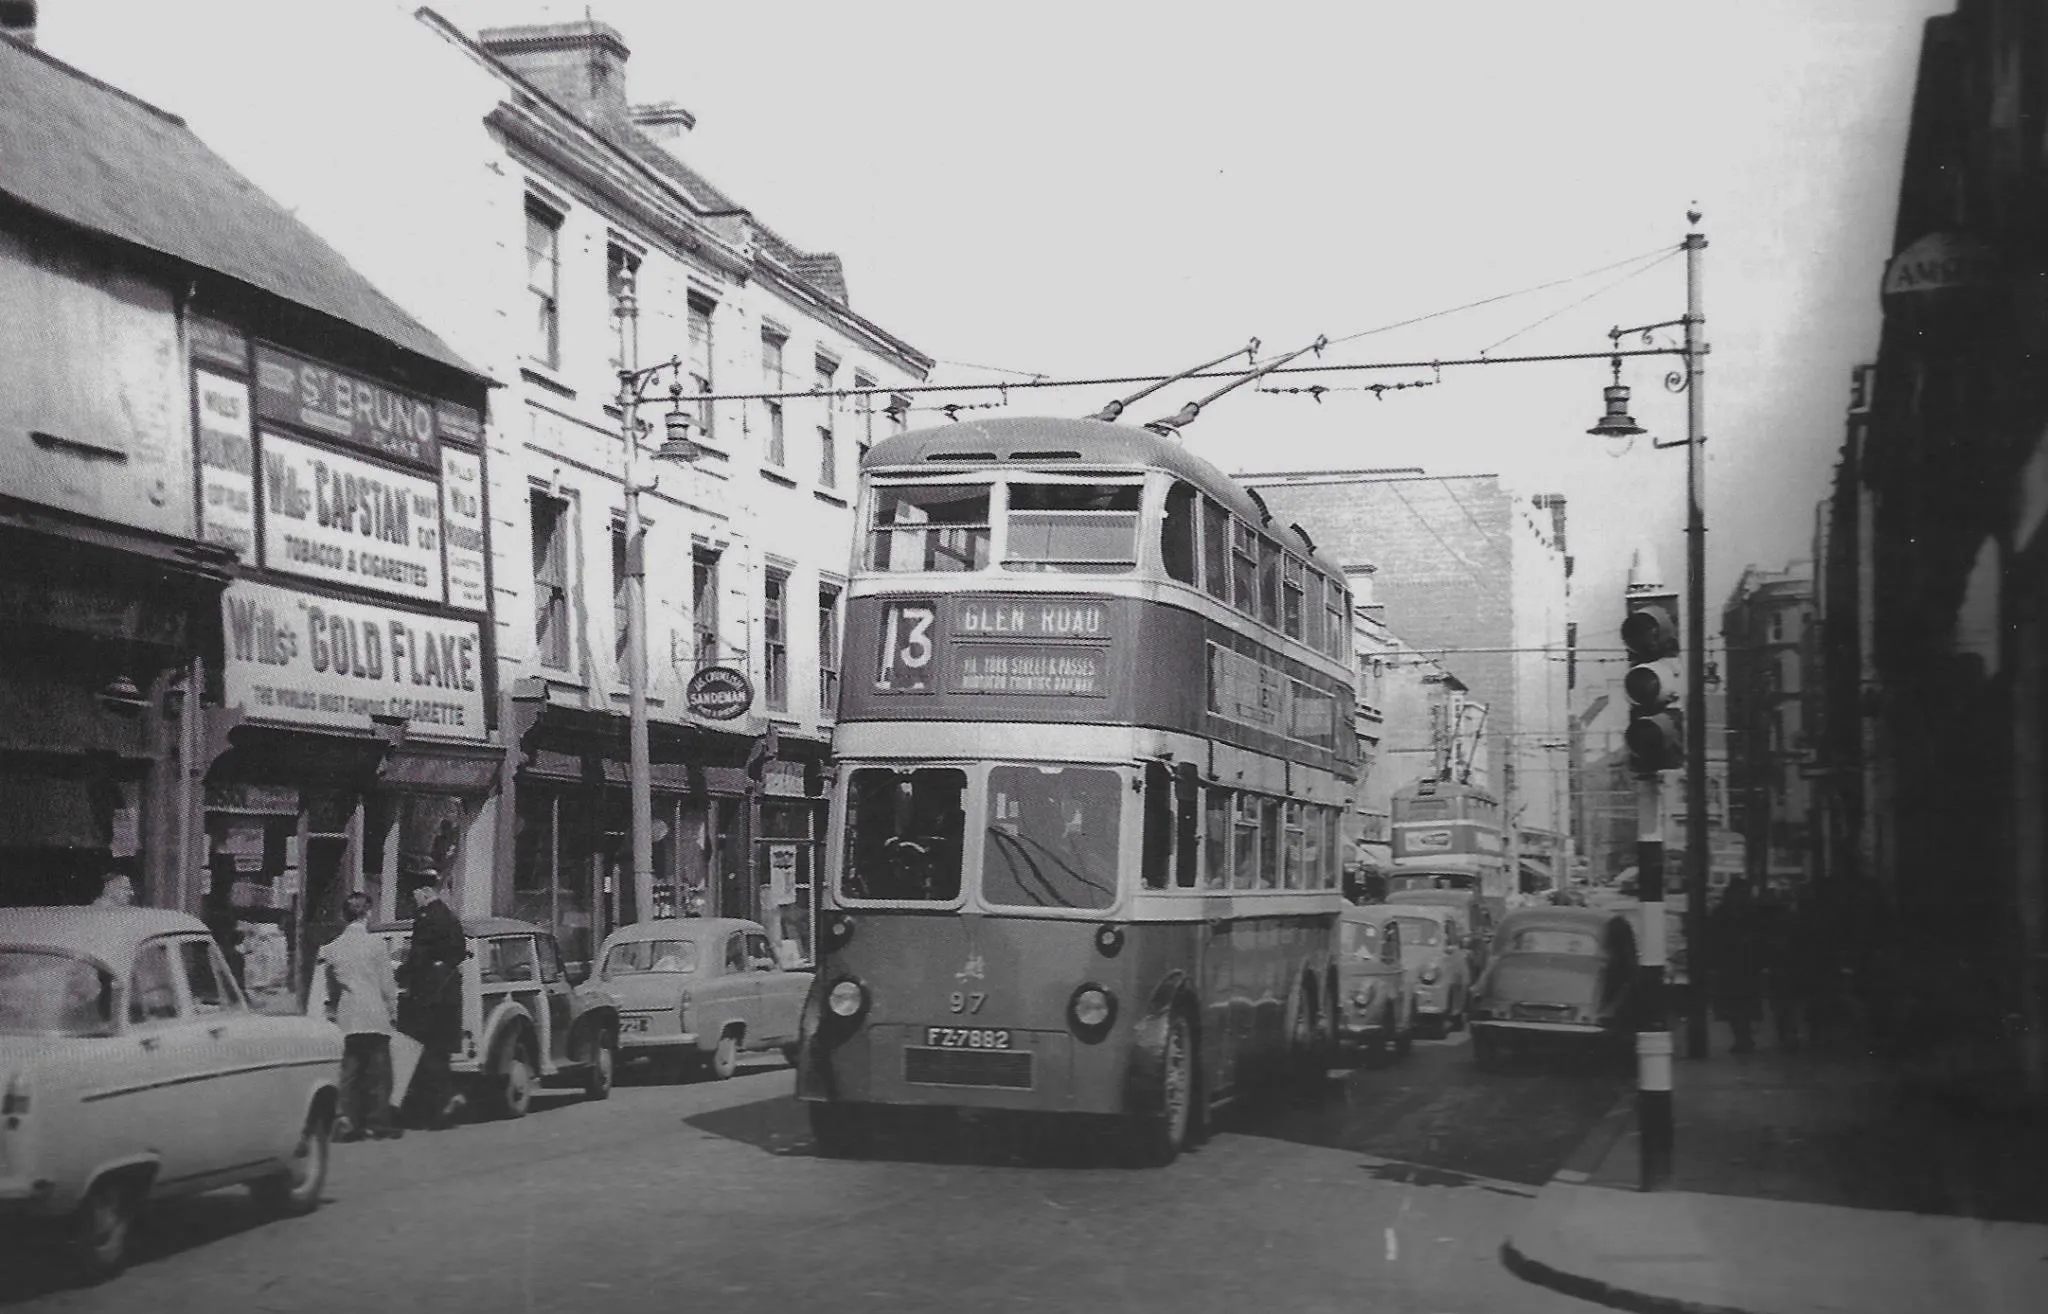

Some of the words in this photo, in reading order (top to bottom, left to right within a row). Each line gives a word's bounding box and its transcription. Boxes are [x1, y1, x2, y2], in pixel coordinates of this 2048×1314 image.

[334, 378, 433, 442] BRUNO
[284, 534, 343, 570] TOBACCO
[346, 549, 358, 572] &
[360, 552, 428, 587] CIGARETTES
[965, 604, 1025, 632] GLEN
[1041, 604, 1100, 633] ROAD
[882, 607, 934, 668] 13
[1011, 657, 1046, 675] STREET
[1058, 658, 1095, 676] PASSES
[389, 697, 465, 727] CIGARETTE
[689, 690, 747, 706] SANDEMAN
[950, 991, 988, 1015] 97
